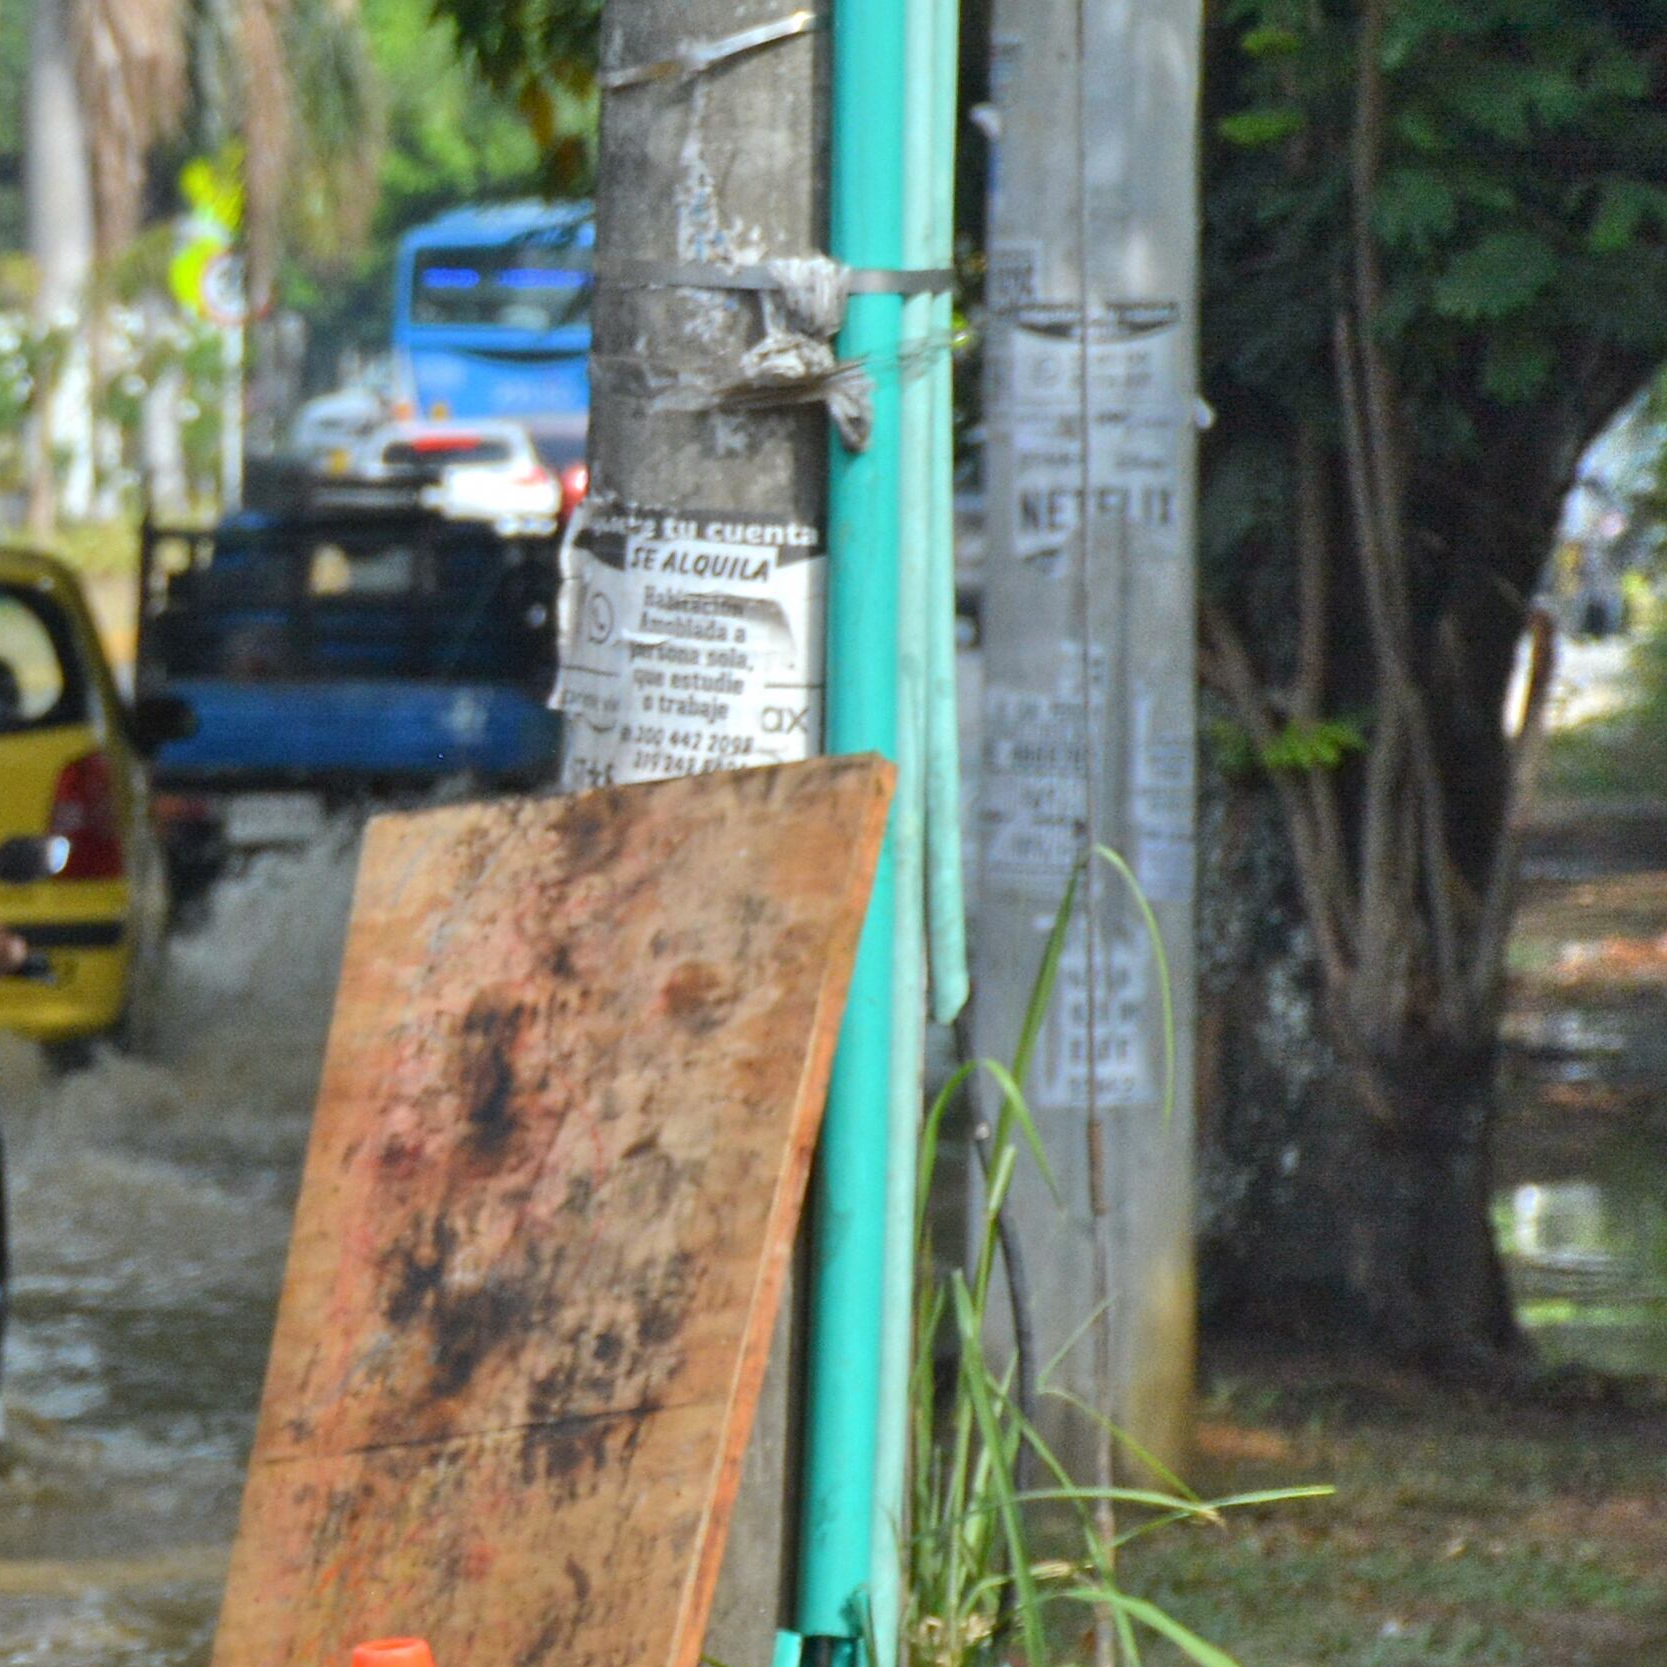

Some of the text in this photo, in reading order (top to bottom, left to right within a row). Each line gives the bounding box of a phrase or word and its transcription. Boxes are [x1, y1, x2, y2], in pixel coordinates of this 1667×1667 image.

[663, 518, 698, 540] tu
[706, 521, 819, 546] cuenta
[630, 547, 771, 581] SE ALQUILA
[734, 627, 747, 643] a
[629, 640, 700, 667] persona
[633, 668, 744, 695] que estudie
[657, 694, 730, 725] trabaje
